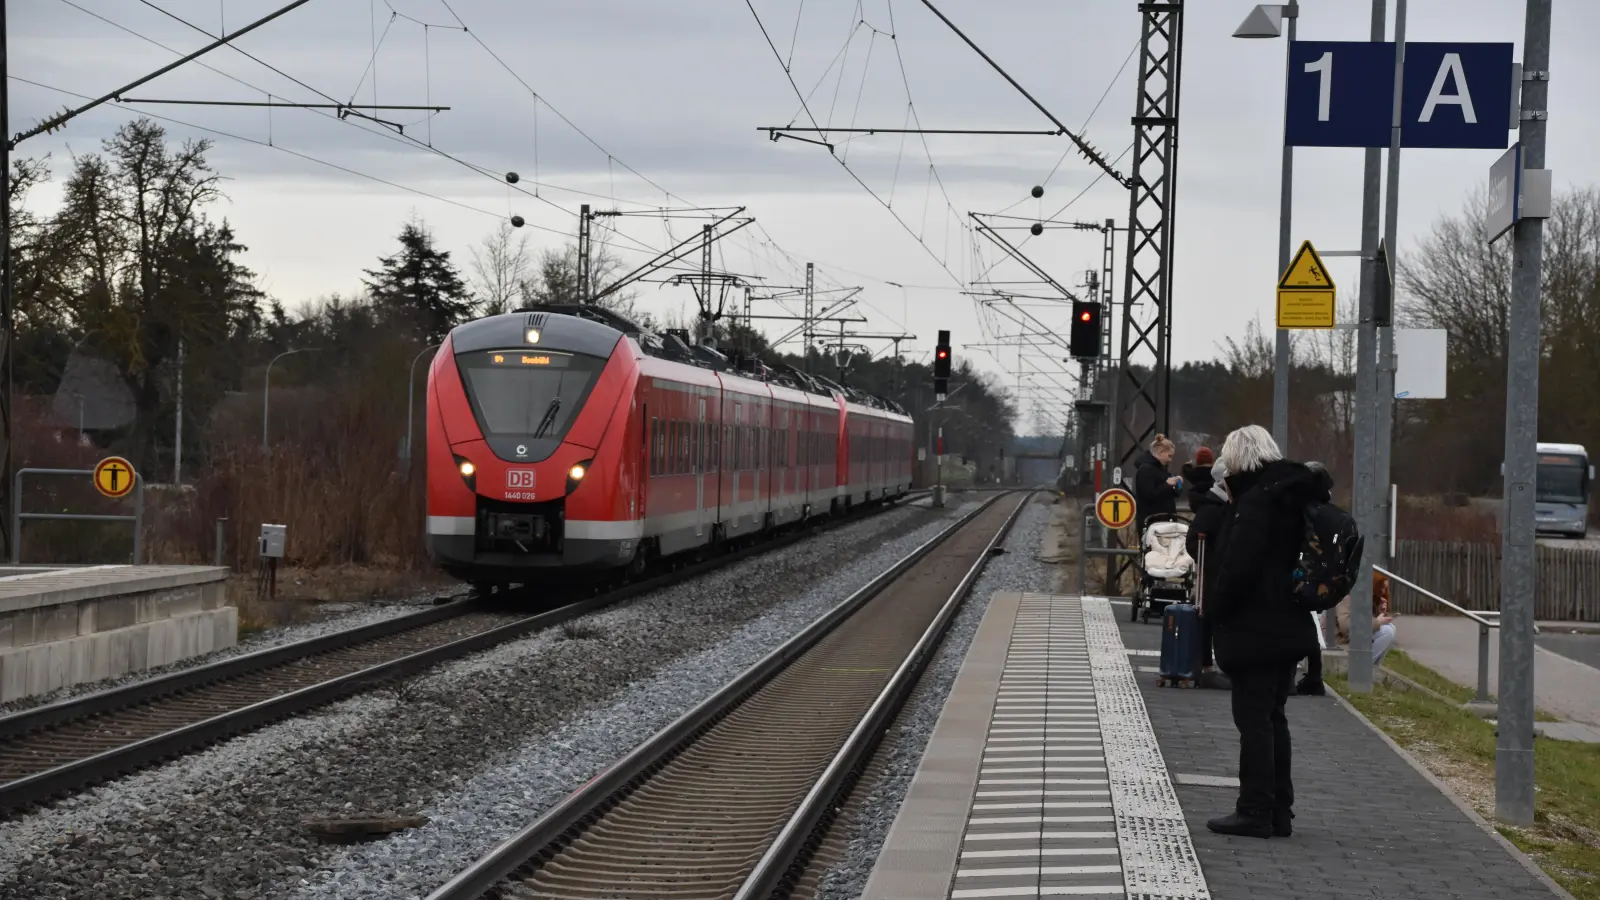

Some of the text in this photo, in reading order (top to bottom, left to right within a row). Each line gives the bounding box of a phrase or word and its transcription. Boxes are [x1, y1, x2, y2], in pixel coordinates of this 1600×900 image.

[1304, 51, 1478, 124] 1 A
[509, 471, 533, 486] DB
[504, 491, 521, 499] 1440
